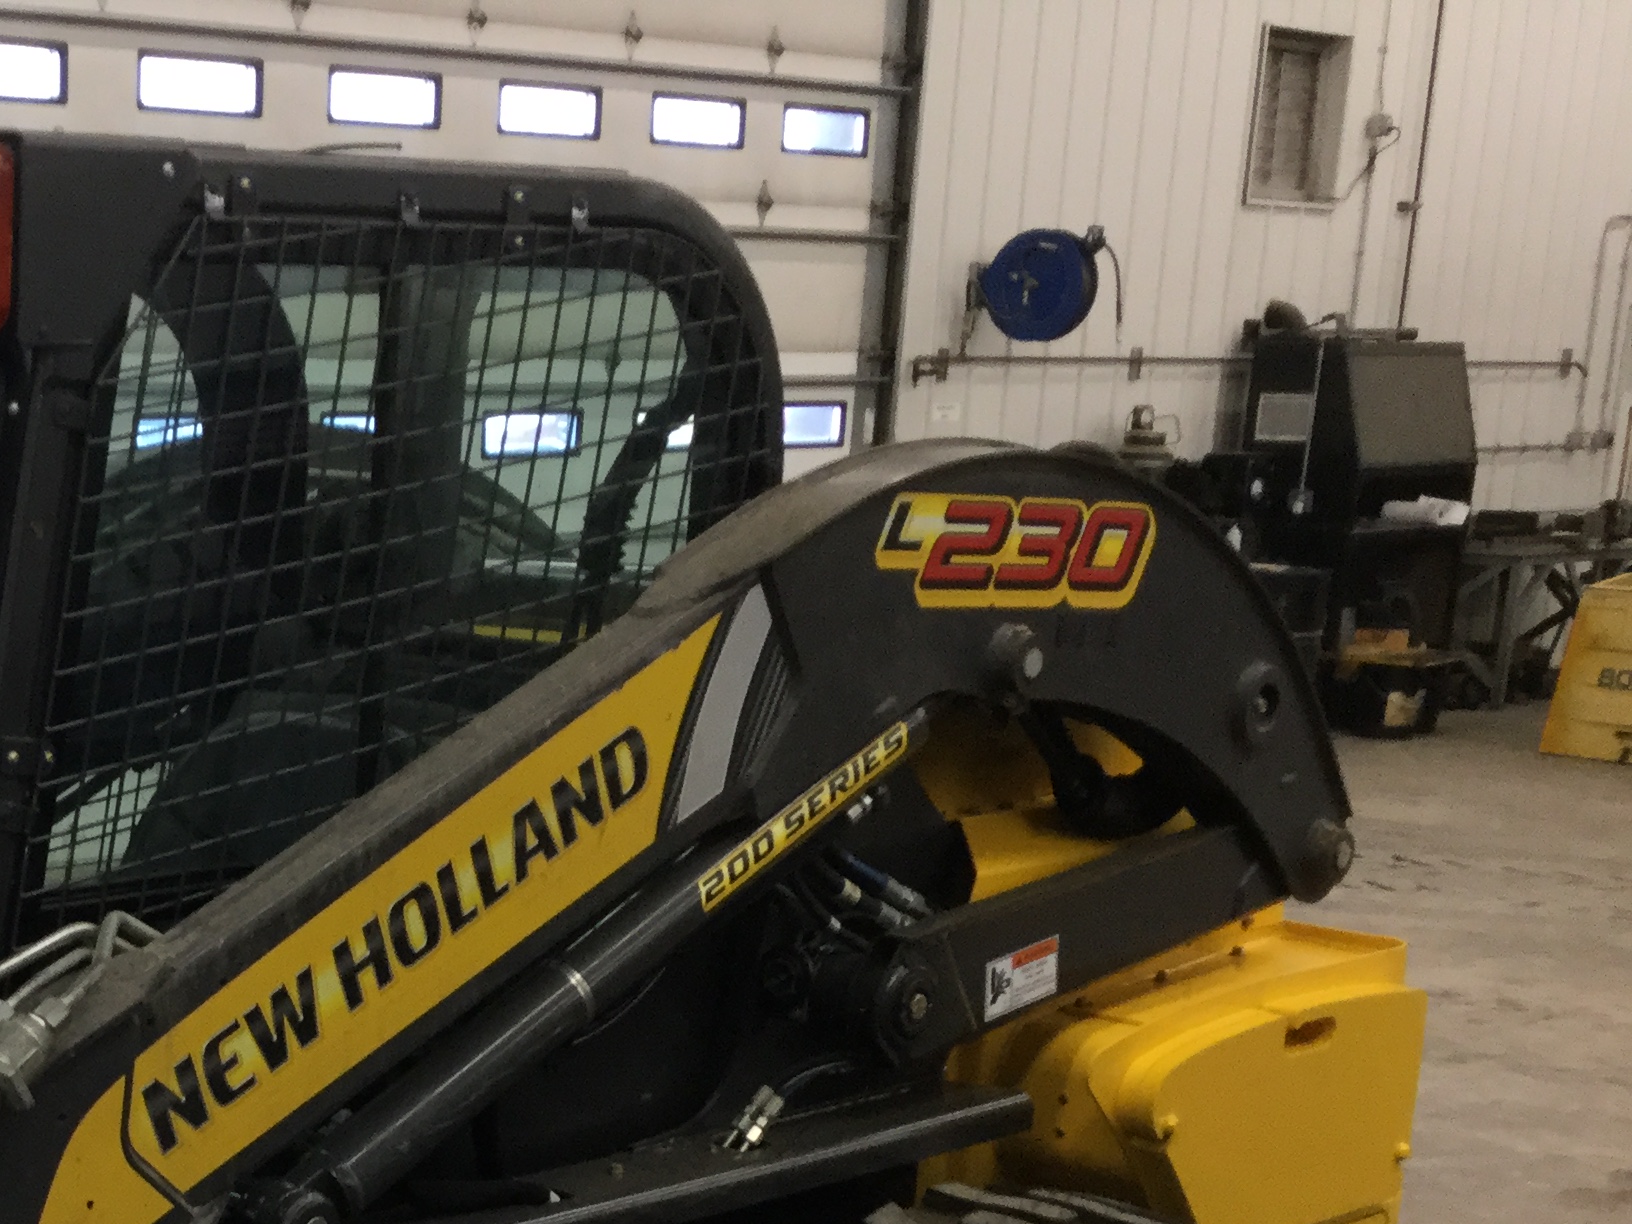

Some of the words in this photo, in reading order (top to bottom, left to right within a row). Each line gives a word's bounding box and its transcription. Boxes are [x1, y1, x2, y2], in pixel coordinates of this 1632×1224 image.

[880, 496, 1154, 597] L230
[701, 828, 775, 903] 200
[783, 726, 904, 840] SERIES
[140, 964, 322, 1156] NEW
[331, 724, 650, 1013] HOLLAND
